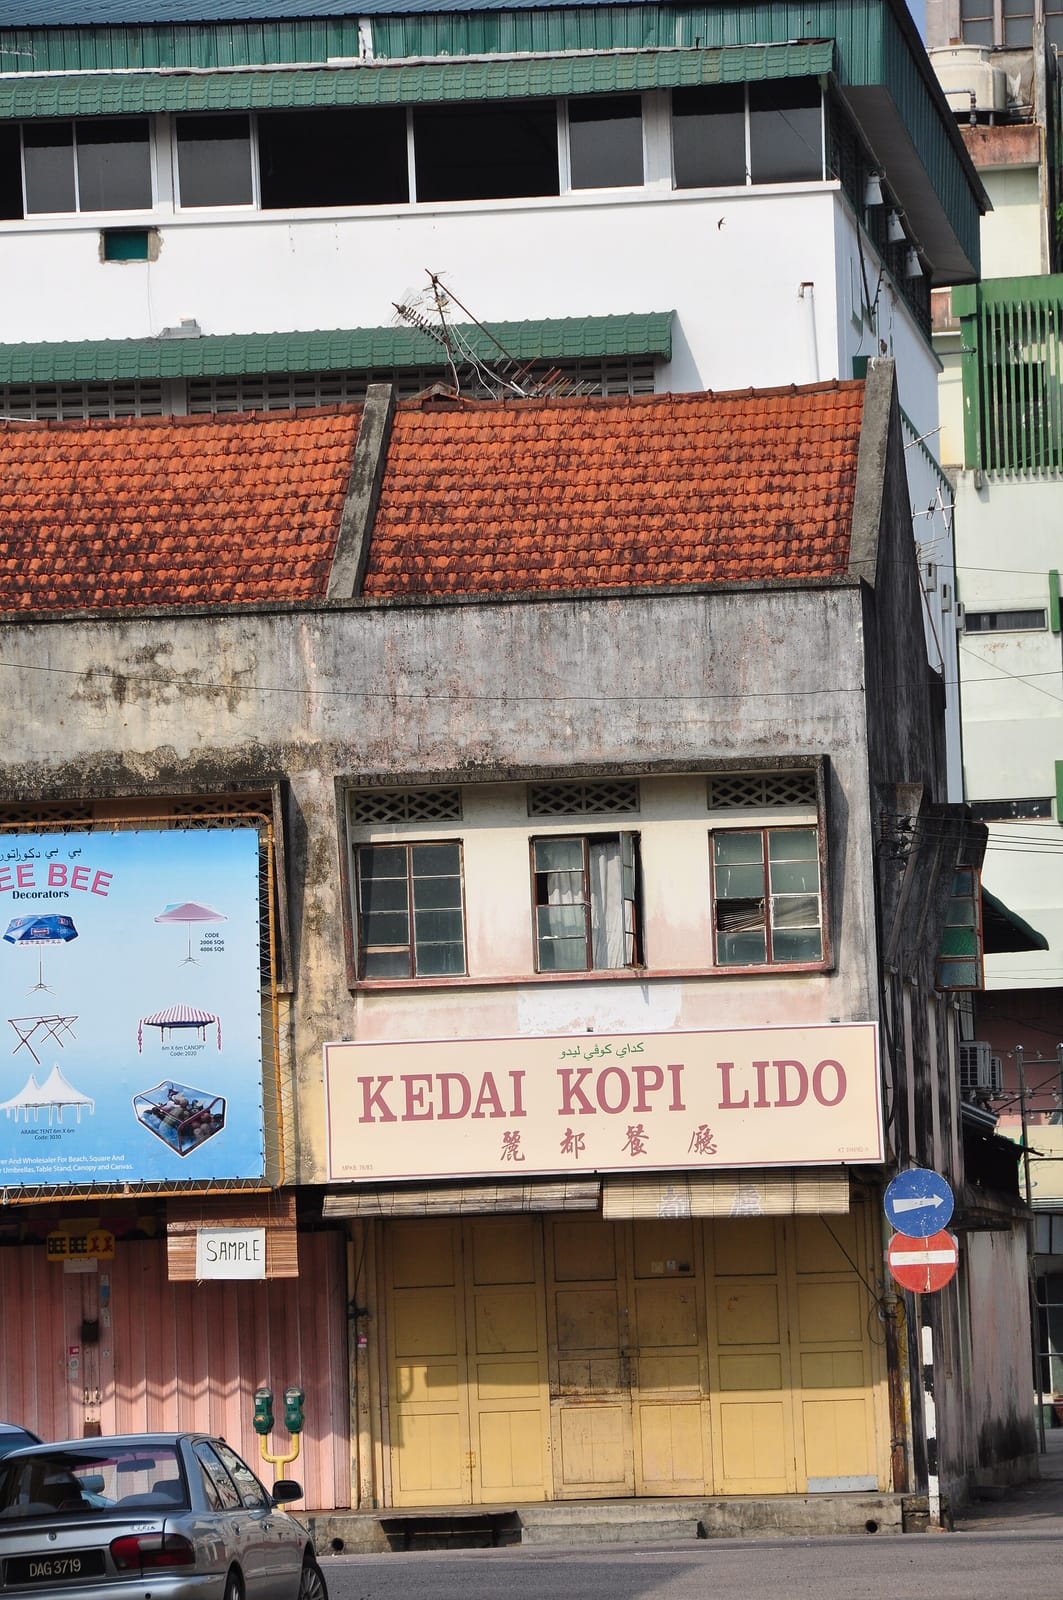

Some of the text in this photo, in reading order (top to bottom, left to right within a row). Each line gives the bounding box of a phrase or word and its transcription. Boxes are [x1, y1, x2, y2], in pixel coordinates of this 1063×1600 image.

[48, 863, 113, 897] BEE
[12, 890, 69, 900] Decorators
[559, 1045, 581, 1059] ليدو
[357, 1059, 847, 1123] KEDAI KOPI LIDO
[22, 1156, 56, 1164] Wholesaler
[88, 1155, 111, 1163] Square
[72, 1164, 96, 1173] Canopy
[97, 1163, 110, 1171] and
[206, 1238, 260, 1262] SAMPLE
[29, 1558, 81, 1577] DAG 3719
